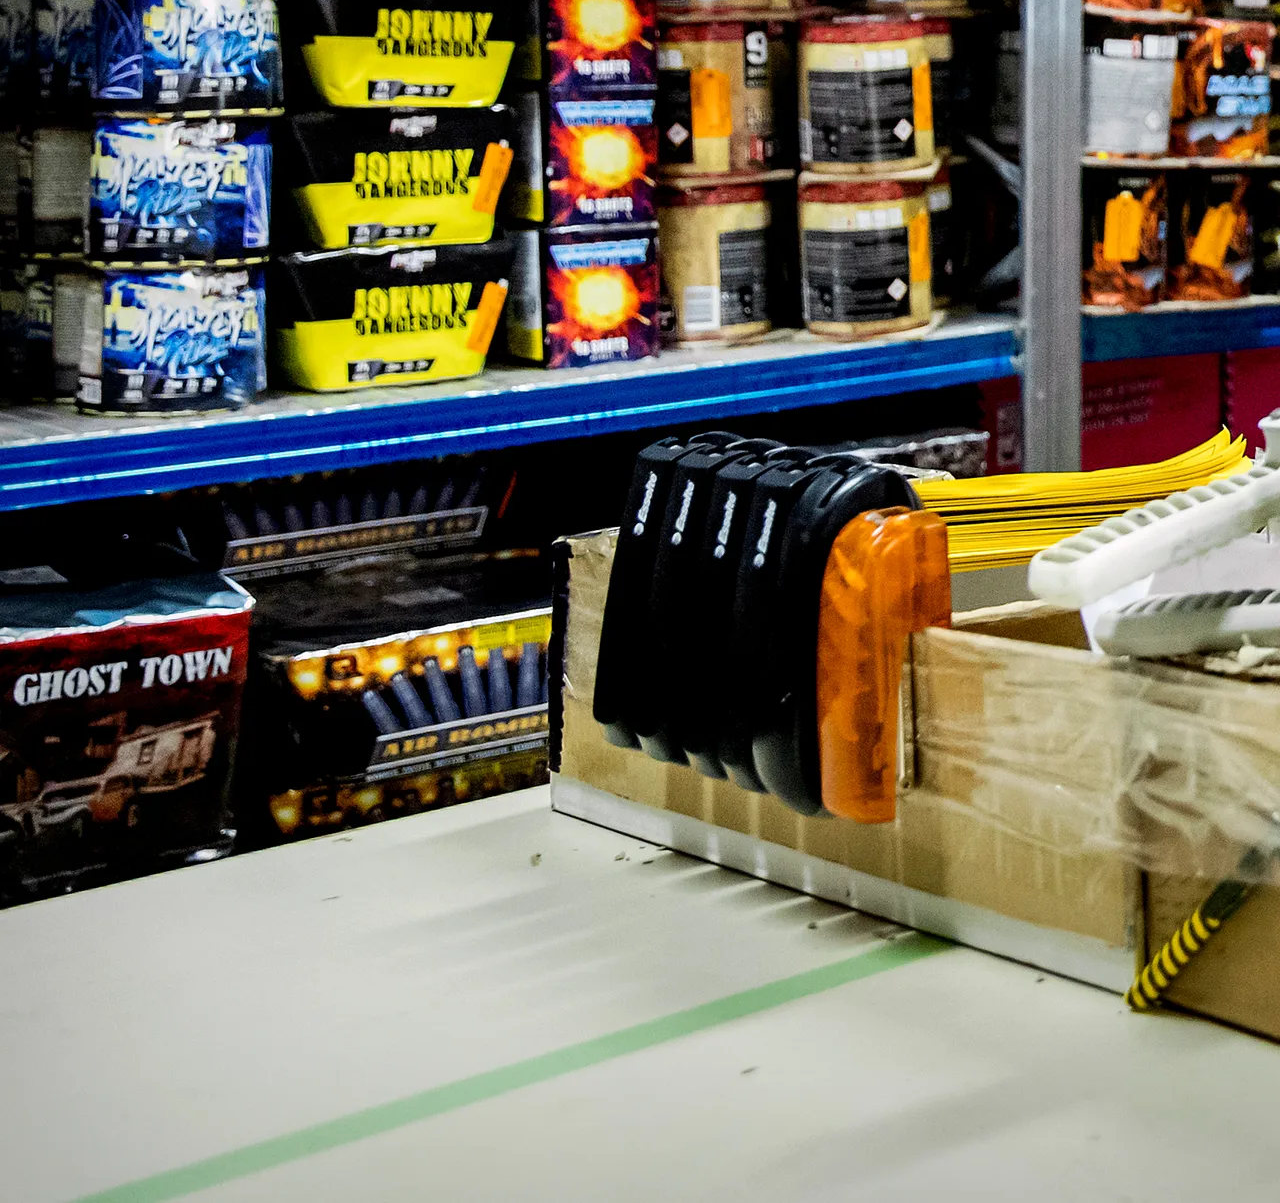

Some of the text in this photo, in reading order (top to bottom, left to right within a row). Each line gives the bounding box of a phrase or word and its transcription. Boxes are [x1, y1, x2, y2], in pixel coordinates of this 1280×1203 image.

[375, 8, 493, 42] JOHNNY
[377, 39, 487, 58] DANGEROUS
[352, 149, 474, 183] JOHNNY
[355, 180, 468, 198] DANGEROUS
[352, 282, 472, 319] JOHNNY
[355, 313, 466, 335] DANGEROUS
[13, 646, 234, 706] GHOST TOWN
